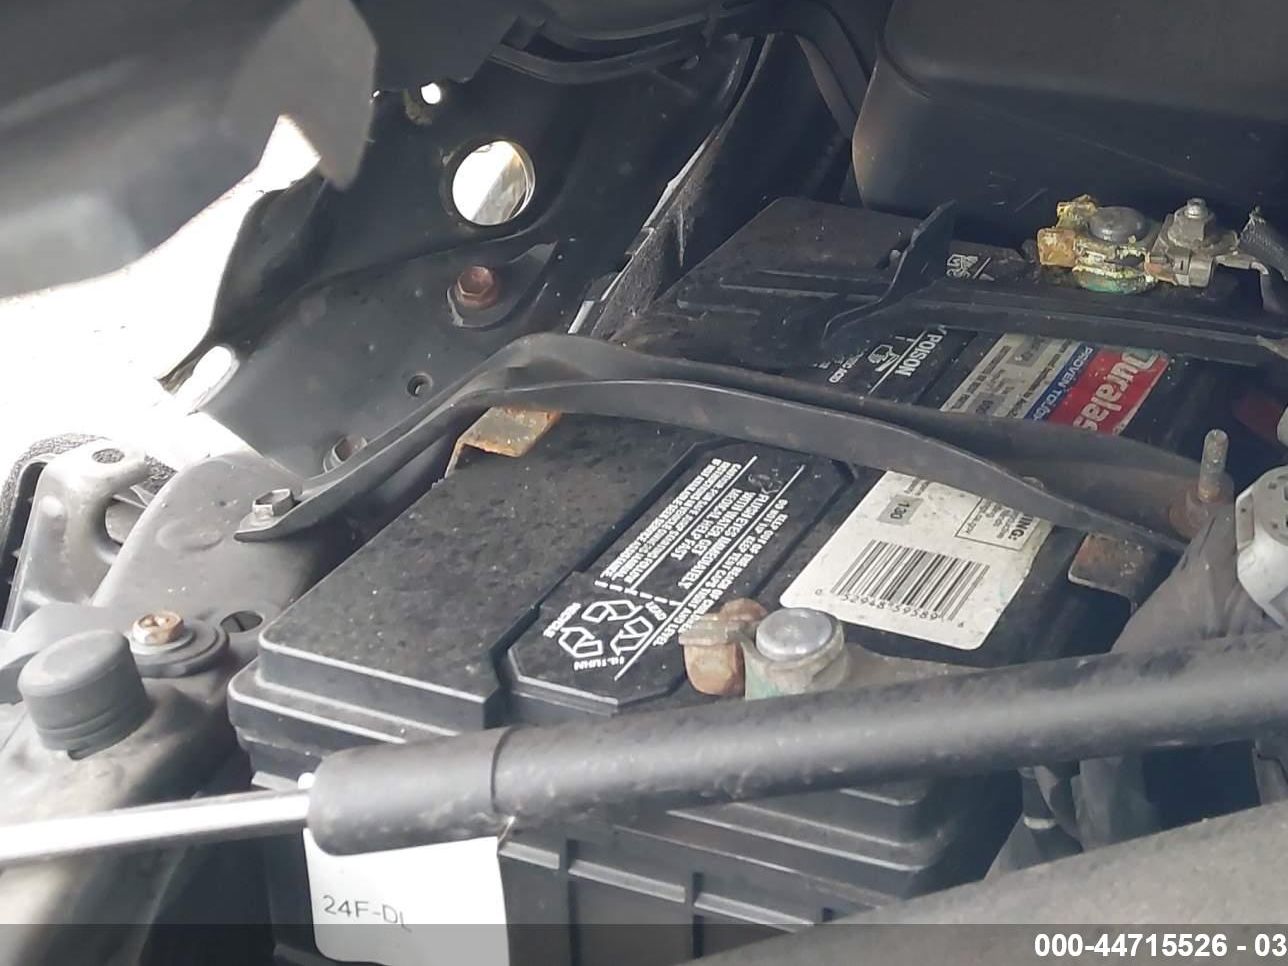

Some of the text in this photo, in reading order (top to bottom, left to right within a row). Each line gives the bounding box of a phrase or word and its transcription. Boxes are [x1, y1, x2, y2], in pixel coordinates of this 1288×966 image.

[894, 334, 943, 377] POISON
[1058, 346, 1094, 388] PROVEN
[730, 491, 756, 510] WITH
[668, 488, 742, 559] MEDICAL HELP FAST
[1007, 513, 1035, 542] ING:
[676, 494, 769, 589] FLUSH EYES IMMEDIATELY
[689, 539, 712, 555] GET
[674, 607, 692, 624] AND
